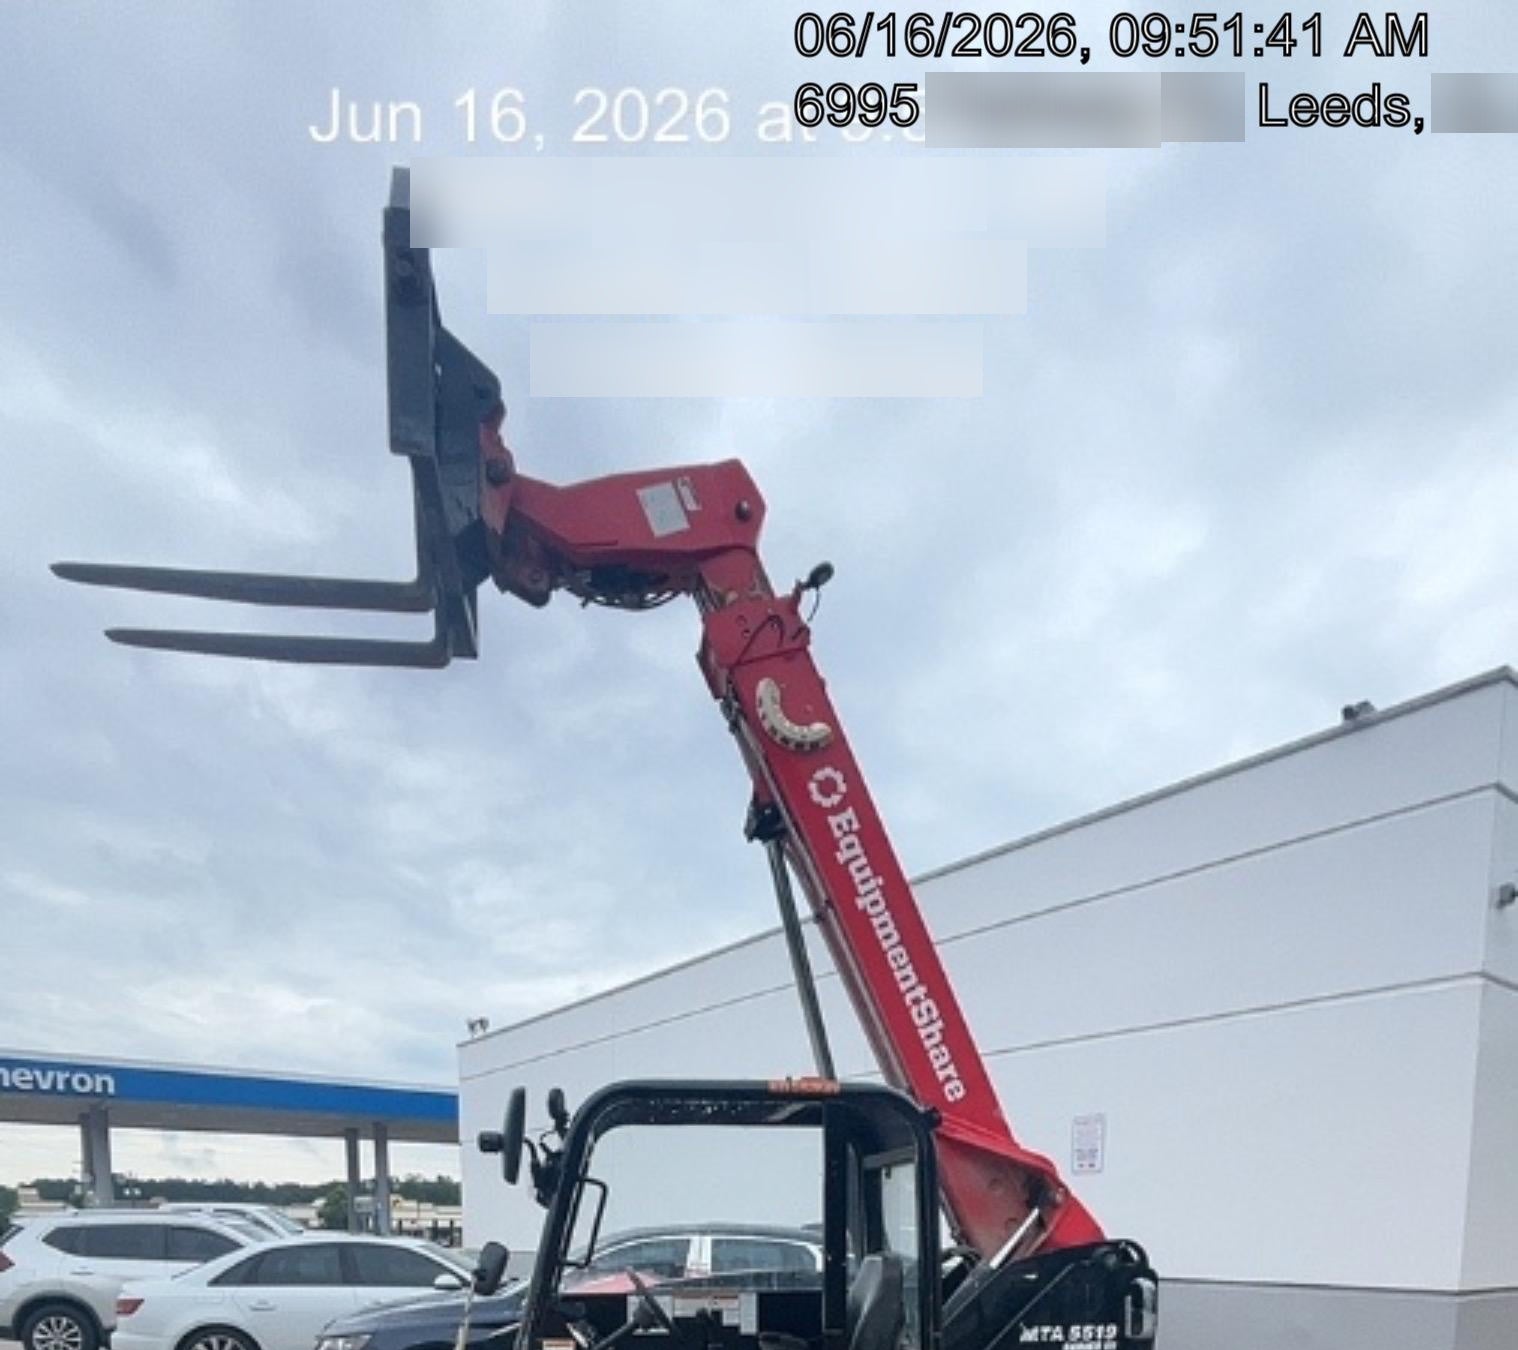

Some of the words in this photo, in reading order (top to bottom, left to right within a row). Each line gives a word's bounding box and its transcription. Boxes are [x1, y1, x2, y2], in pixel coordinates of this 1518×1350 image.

[827, 805, 966, 1102] EquipmentShare
[1019, 1324, 1065, 1342] MTA
[1067, 1324, 1118, 1341] 5519
